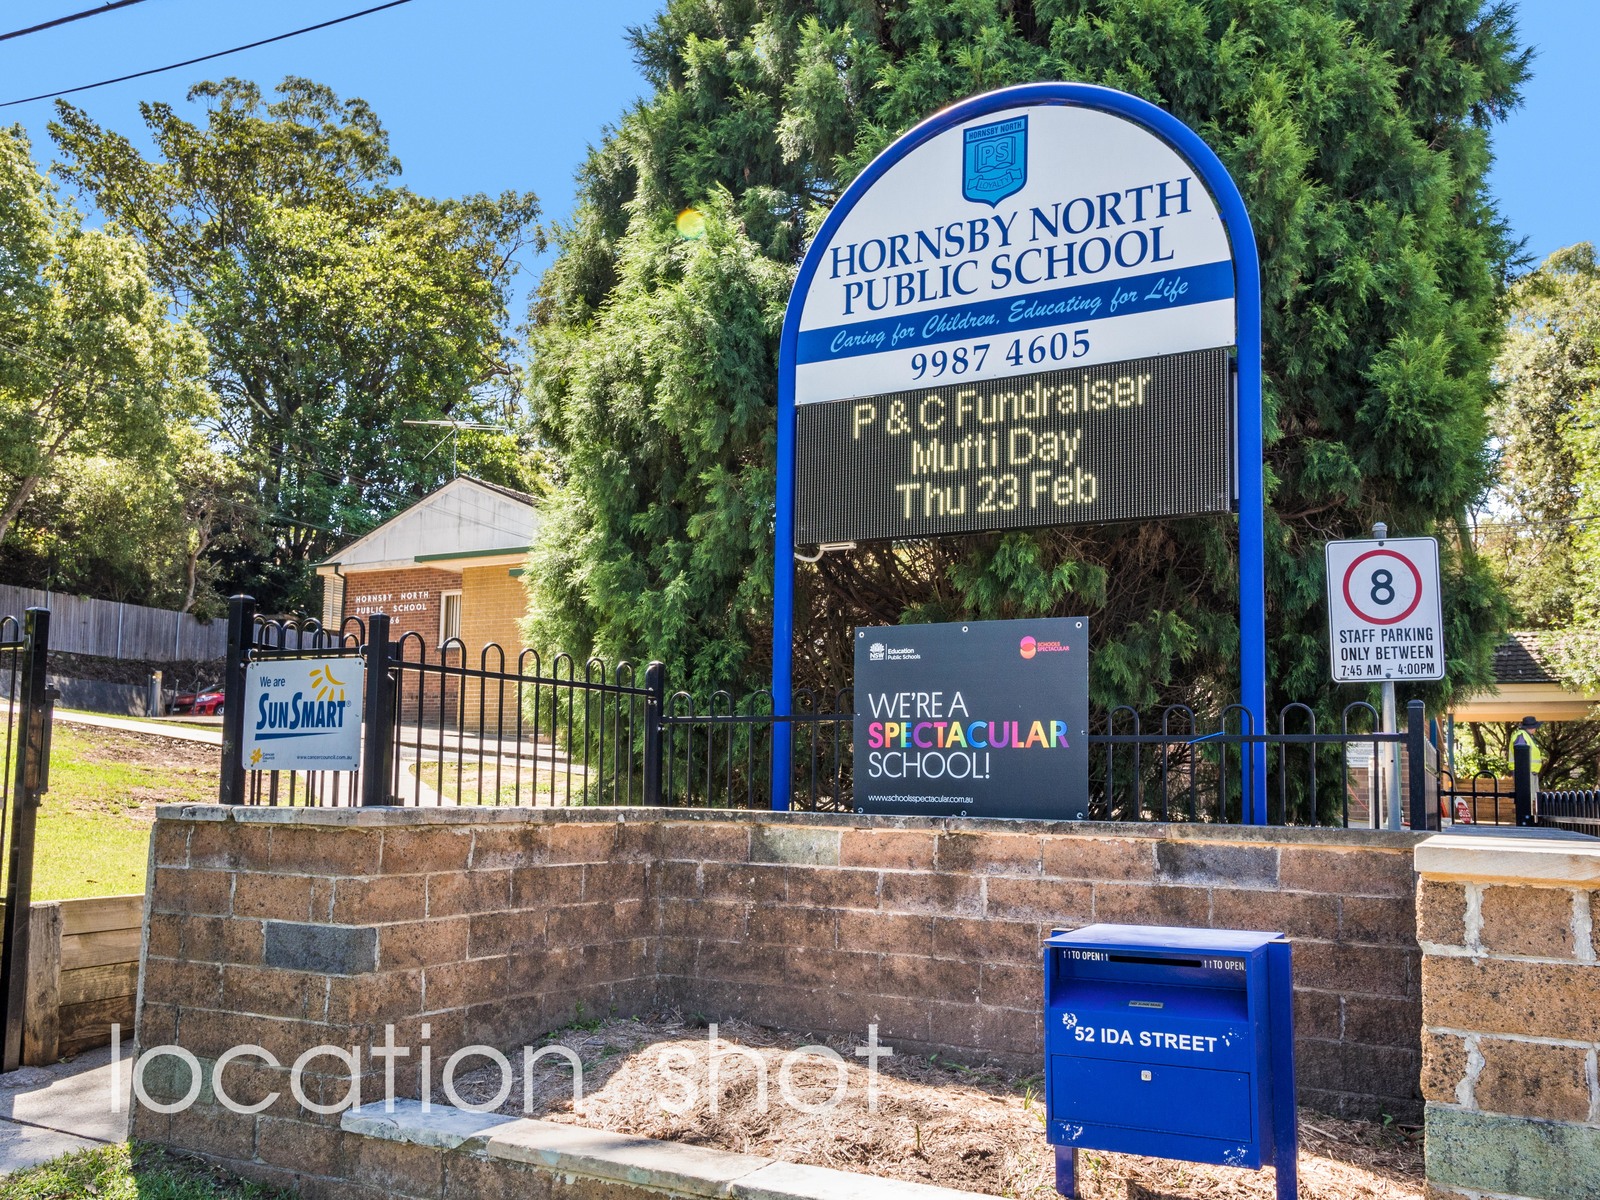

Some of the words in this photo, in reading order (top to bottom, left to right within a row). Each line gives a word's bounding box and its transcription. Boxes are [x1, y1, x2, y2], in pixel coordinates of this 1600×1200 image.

[968, 127, 998, 140] HORNSBY
[1000, 121, 1022, 133] NORTH
[981, 142, 1010, 166] PS
[980, 176, 1009, 189] LOYALTY
[830, 211, 1018, 279] HORNSBY
[1032, 177, 1192, 241] NORTH
[843, 260, 979, 316] PUBLIC
[991, 226, 1175, 290] SCHOOL
[830, 330, 887, 353] Caring
[891, 323, 915, 346] for
[922, 312, 1000, 338] Children,
[1008, 295, 1102, 323] Educating
[1109, 288, 1138, 312] for
[1144, 279, 1189, 302] Life
[911, 343, 990, 380] 9987
[1005, 329, 1091, 367] 4605
[853, 404, 875, 439] P
[886, 400, 911, 434] &
[919, 395, 945, 430] C
[956, 372, 1151, 426] Fundraiser
[913, 431, 997, 475] Mufti
[1010, 427, 1081, 467] Day
[896, 481, 965, 518] Thu
[977, 473, 1018, 512] 23
[1031, 467, 1096, 508] Feb
[356, 594, 392, 603] HORNSBY
[400, 591, 429, 600] NORTH
[1370, 569, 1395, 606] 8
[356, 605, 383, 614] PUBLIC
[393, 603, 427, 612] SCHOOL
[1340, 629, 1375, 643] STAFF
[1381, 627, 1433, 642] PARKING
[1341, 647, 1370, 661] ONLY
[1376, 645, 1434, 660] BETWEEN
[260, 676, 271, 687] We
[273, 678, 286, 687] are
[1341, 665, 1362, 676] 7:45
[1367, 664, 1382, 676] AM
[1398, 663, 1435, 674] 4:00PM
[868, 692, 943, 718] WE'RE
[948, 692, 969, 718] A
[868, 720, 1070, 749] SPECTACULAR
[868, 751, 991, 779] SCHOOL!
[868, 794, 974, 803] www.schoolsspectacular.com.au
[1071, 950, 1080, 960] TO
[1082, 951, 1100, 961] OPEN
[1213, 960, 1223, 970] TO
[1224, 960, 1245, 970] OPEN
[1074, 1026, 1095, 1043] 52
[1101, 1028, 1134, 1046] IDA
[1139, 1031, 1218, 1053] STREET
